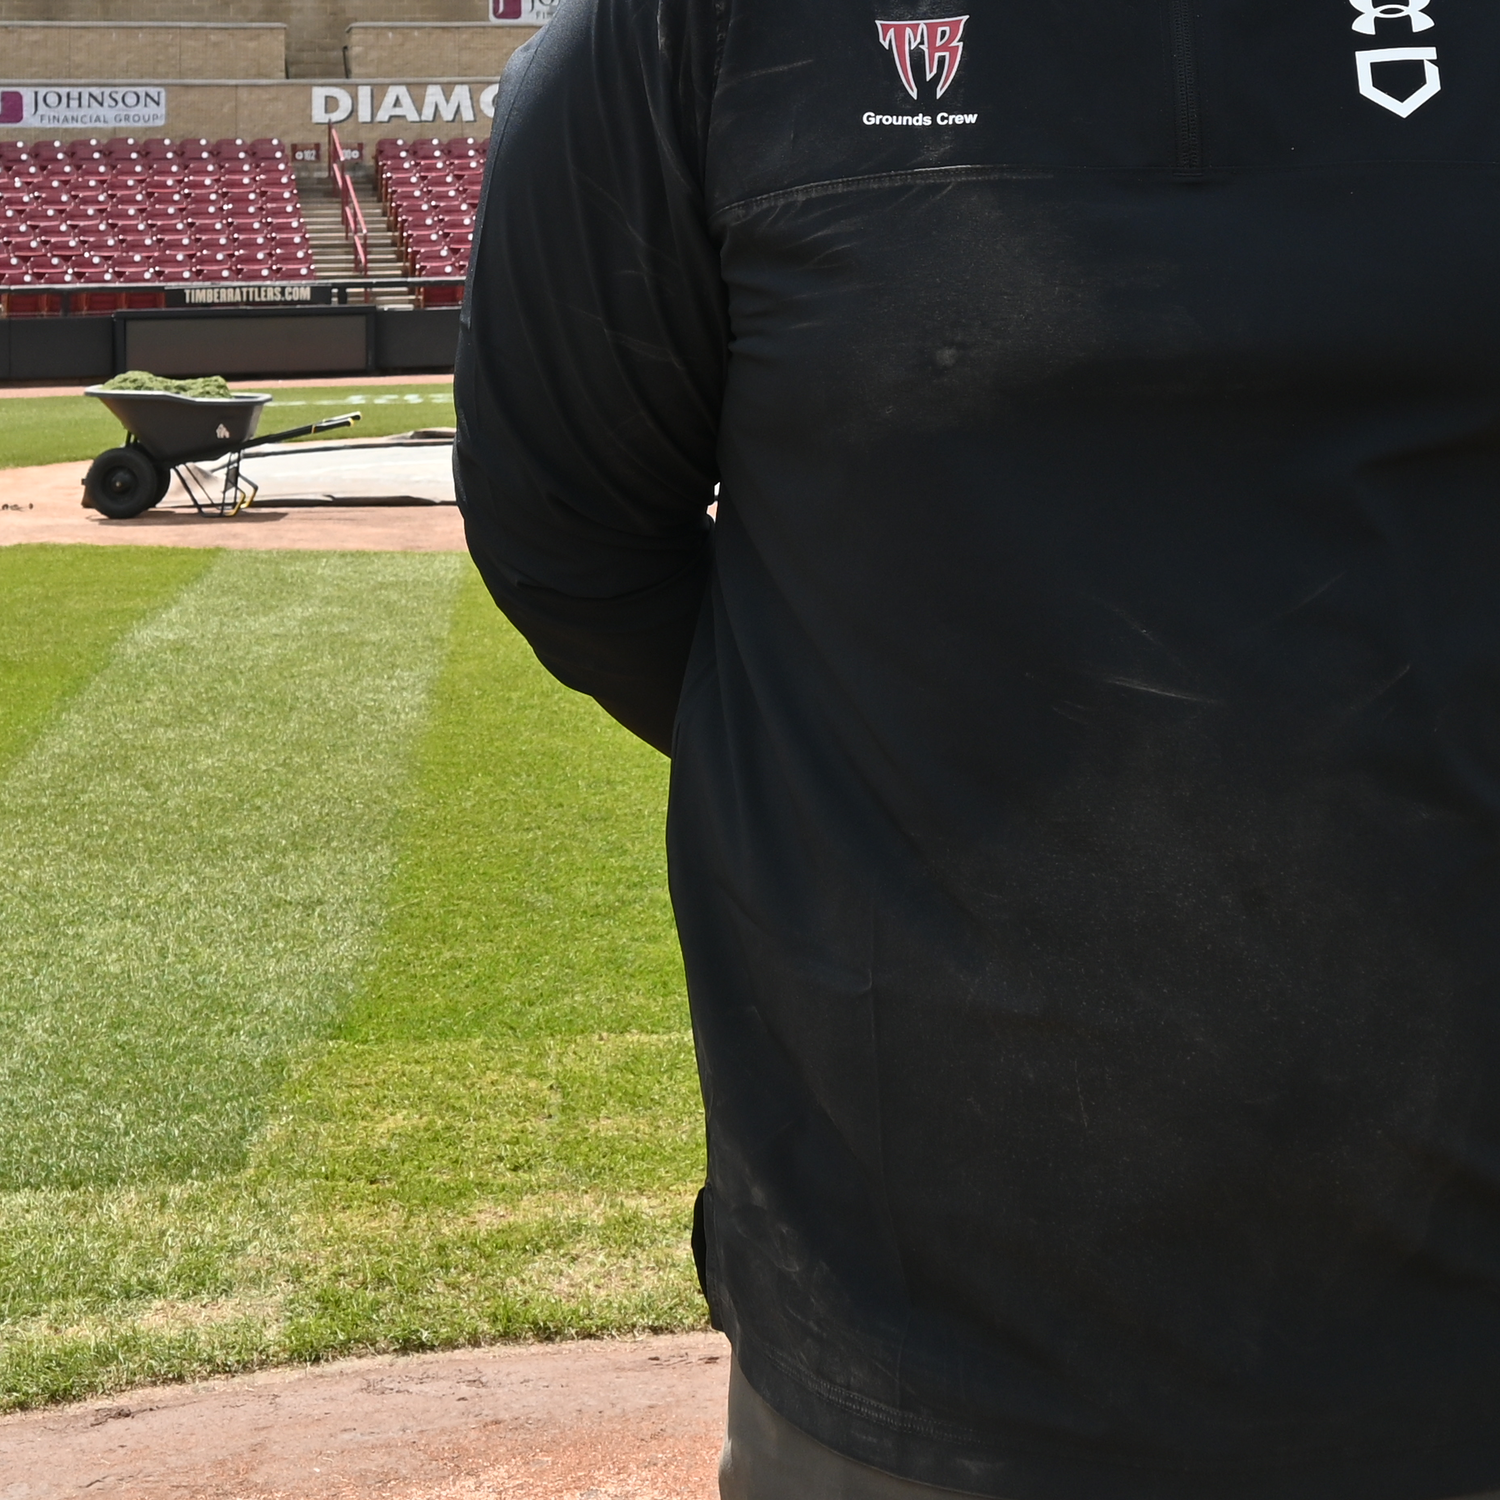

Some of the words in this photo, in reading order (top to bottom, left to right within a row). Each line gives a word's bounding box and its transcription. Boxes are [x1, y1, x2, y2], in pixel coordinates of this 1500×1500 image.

[875, 15, 970, 100] TR
[32, 90, 162, 116] JOHNSON
[40, 113, 109, 125] FINANCIAL
[114, 113, 158, 124] GROUP
[862, 111, 932, 126] Grounds
[936, 111, 978, 126] Crew
[184, 286, 311, 304] TIMBERRATTLERS.COM
